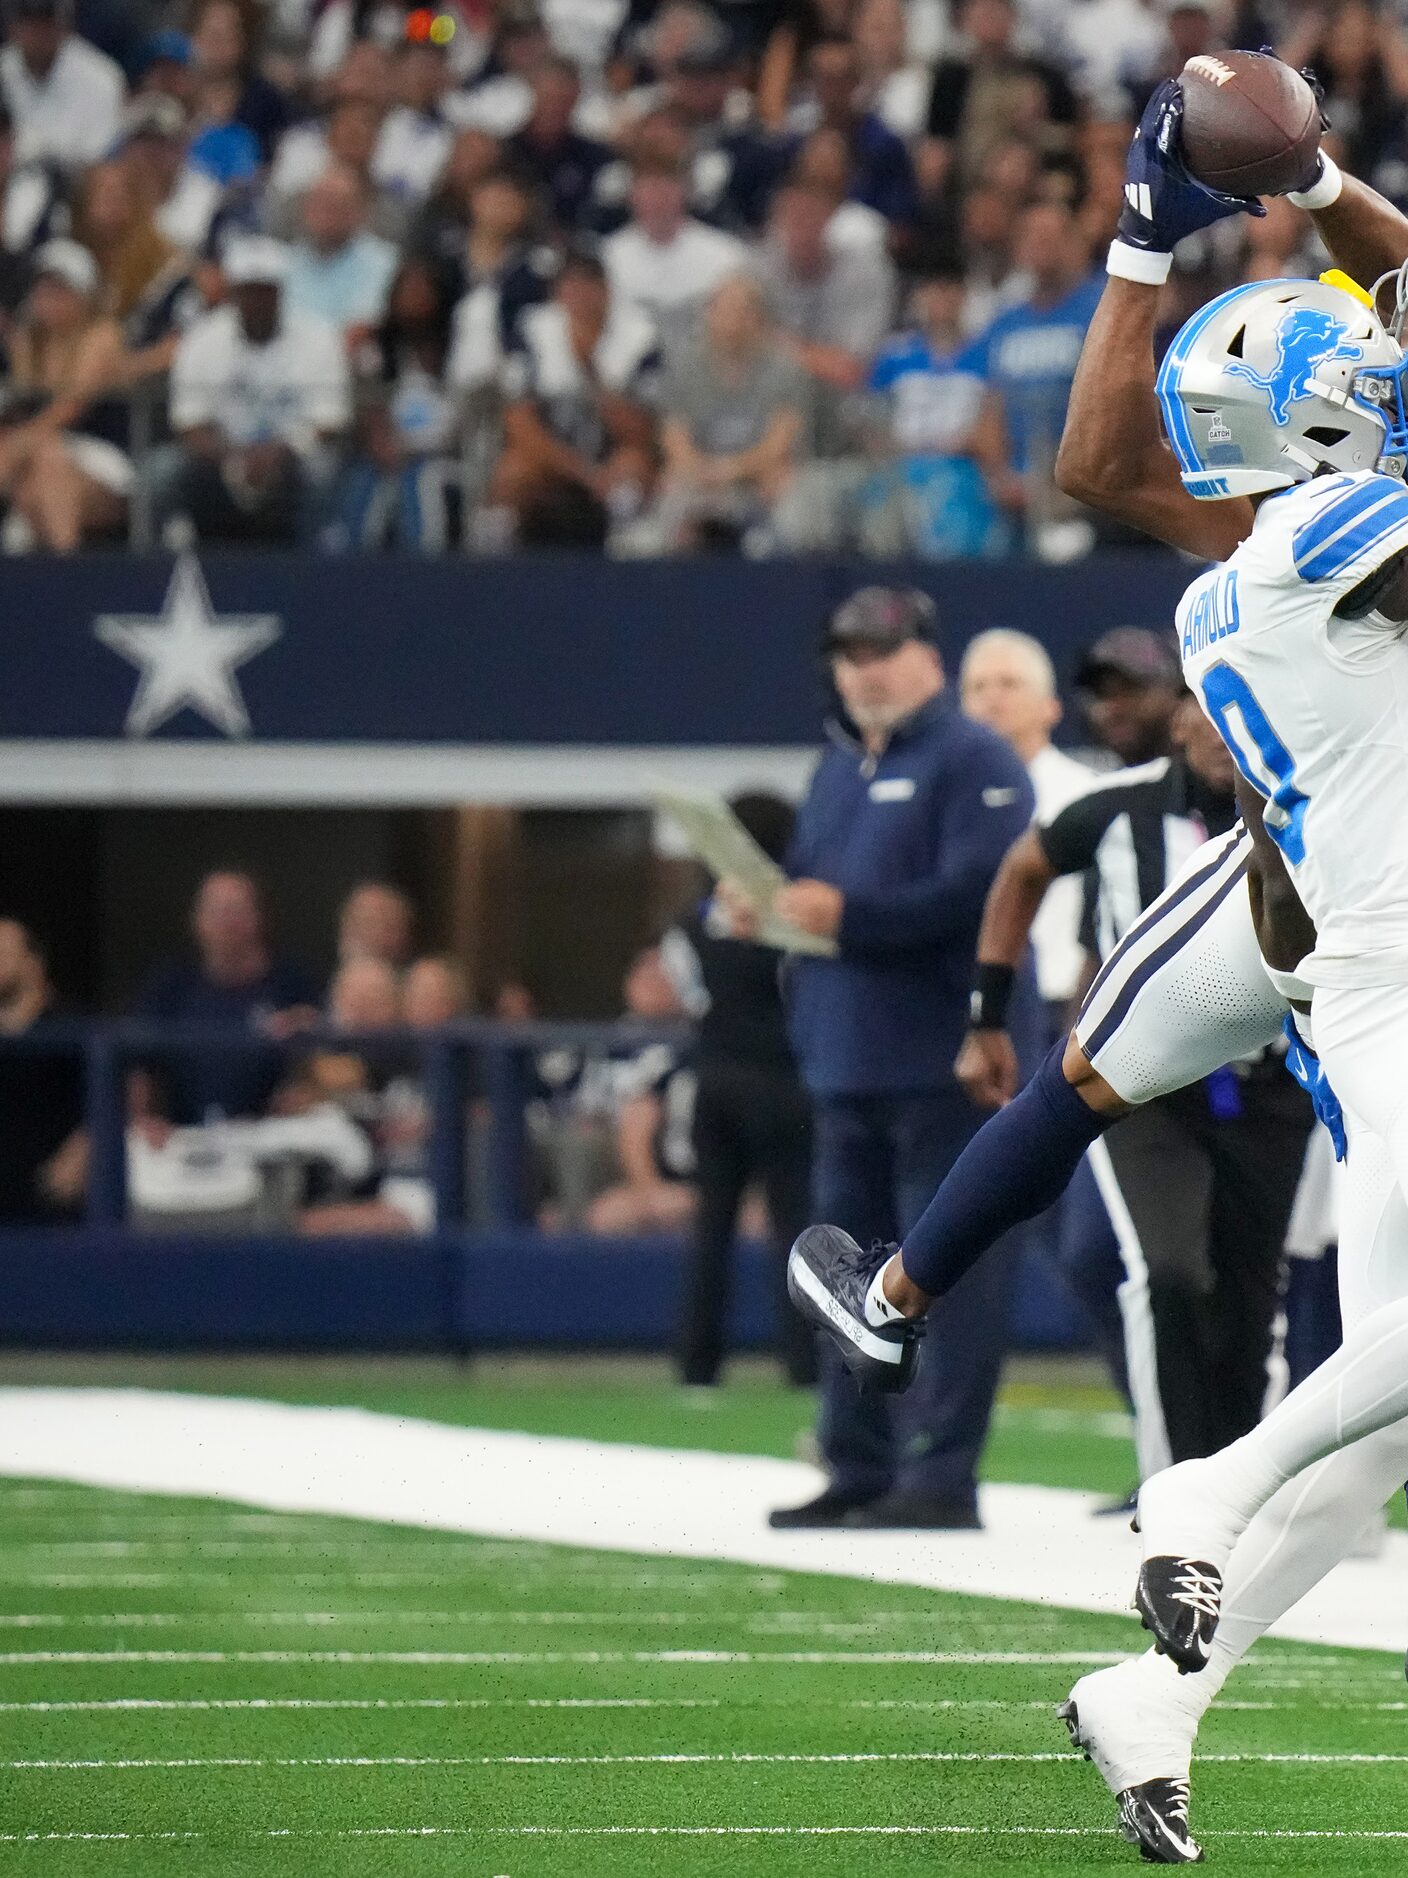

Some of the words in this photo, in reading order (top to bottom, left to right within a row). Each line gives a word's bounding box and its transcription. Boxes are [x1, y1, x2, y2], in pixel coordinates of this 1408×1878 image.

[1209, 429, 1230, 439] CATCH
[1183, 569, 1240, 660] ARNOLD
[1202, 658, 1311, 871] 0
